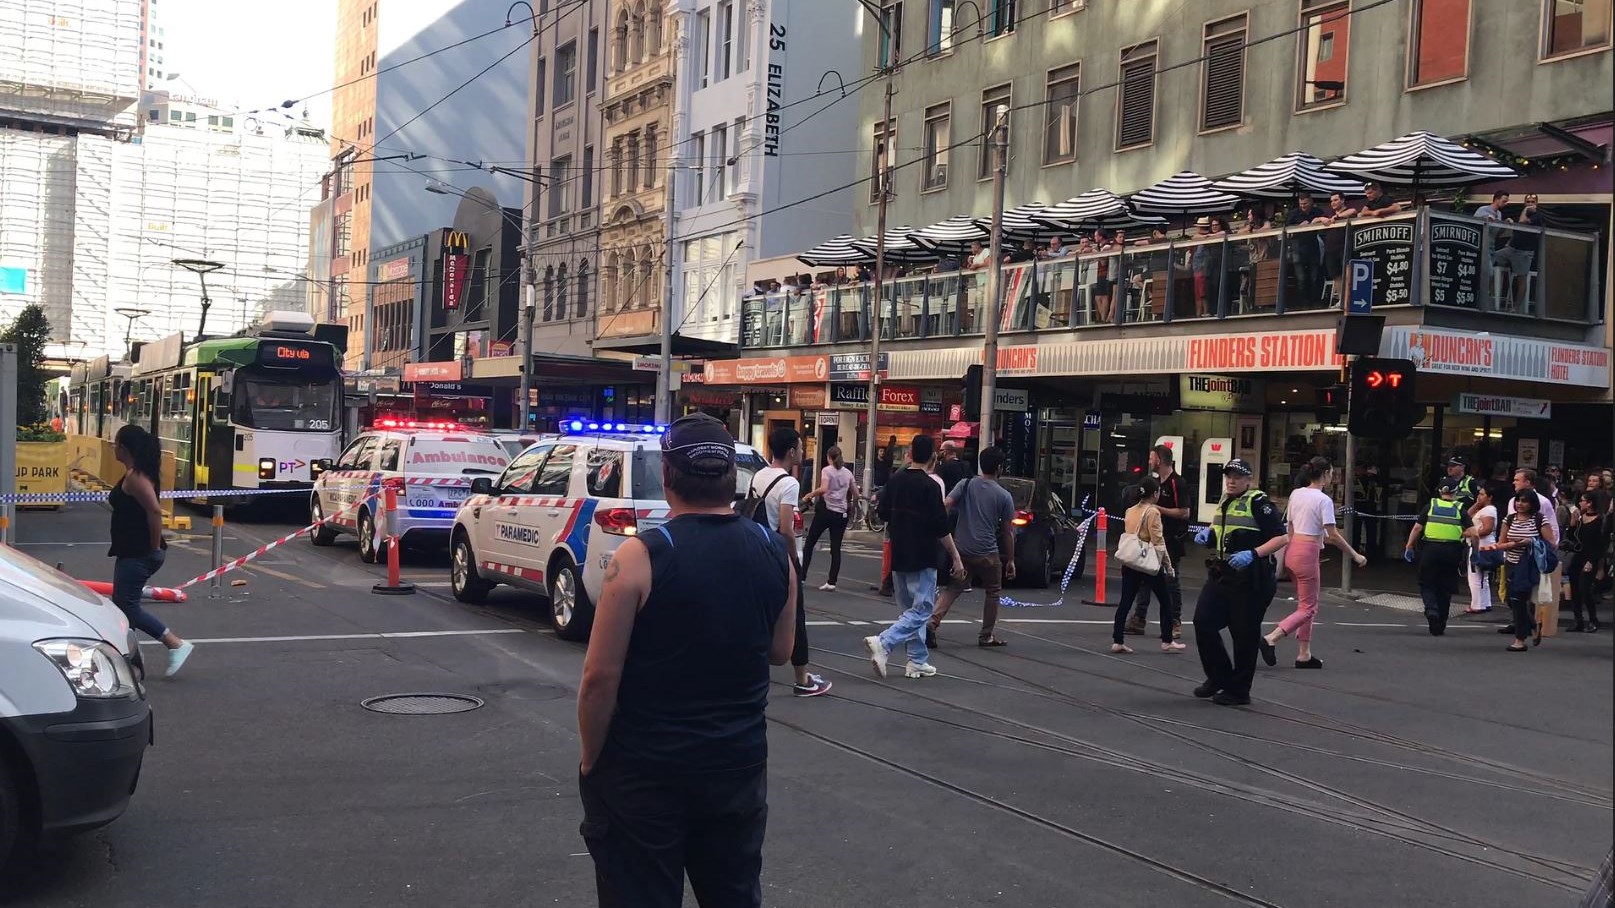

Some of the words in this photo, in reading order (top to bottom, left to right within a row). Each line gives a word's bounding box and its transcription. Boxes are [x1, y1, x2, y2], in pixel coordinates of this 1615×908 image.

[769, 22, 786, 51] 25
[764, 63, 782, 157] ELIZABETH
[1357, 226, 1410, 246] SMIRNOFF
[1433, 226, 1478, 244] SMIRNOFF
[1387, 261, 1409, 275] $4.80
[1437, 261, 1447, 273] $7
[448, 255, 457, 306] McDonald's
[1353, 264, 1370, 290] P
[1386, 289, 1408, 303] $5.50
[1435, 289, 1445, 301] $5
[1456, 291, 1475, 304] $5.50
[277, 347, 295, 358] City
[296, 350, 310, 359] via
[1189, 336, 1257, 369] FLINDERS
[1260, 333, 1327, 367] STATION
[1431, 334, 1493, 366] DUNCAN'S
[1551, 347, 1581, 364] FLINDERS
[1582, 349, 1608, 367] STATION
[833, 354, 855, 363] FOREIGN
[736, 364, 756, 380] happy
[1551, 364, 1569, 380] HOTEL
[836, 386, 872, 400] Raffle
[882, 388, 915, 402] Forex
[996, 394, 1024, 405] nders
[309, 420, 328, 429] 205
[244, 433, 254, 441] 205
[411, 451, 507, 467] Ambulance
[32, 467, 59, 477] PARK
[416, 499, 434, 507] 000
[500, 523, 540, 544] PARAMEDIC
